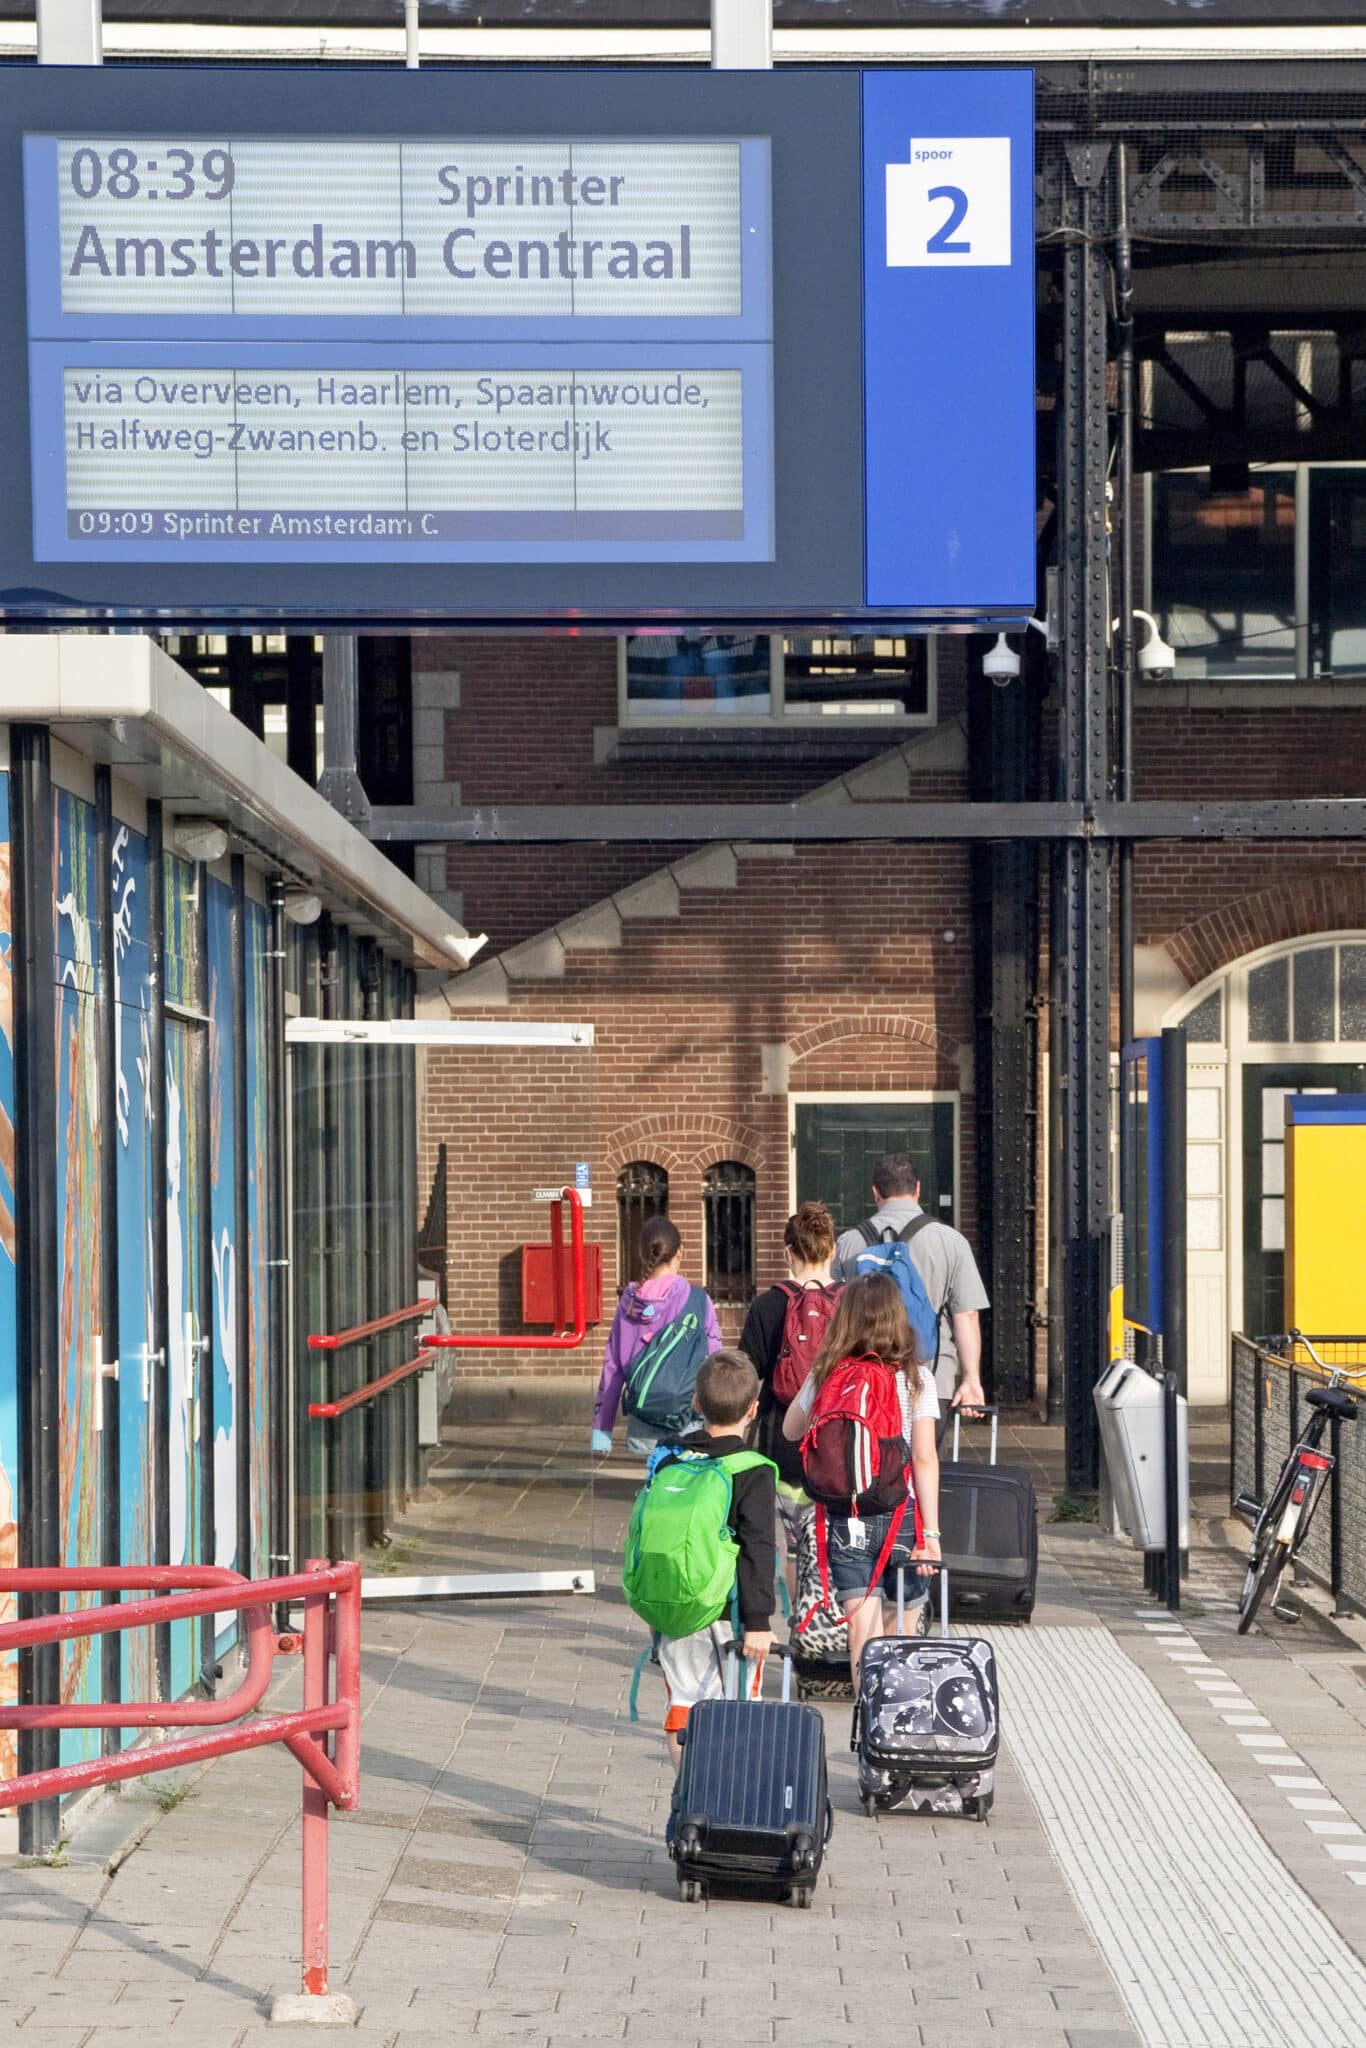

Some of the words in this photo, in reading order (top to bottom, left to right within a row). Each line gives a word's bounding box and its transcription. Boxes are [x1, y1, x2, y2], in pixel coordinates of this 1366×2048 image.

[914, 150, 953, 163] spoor
[71, 148, 235, 200] 08:39
[438, 164, 625, 218] Sprinter
[926, 185, 971, 253] 2
[68, 223, 417, 279] Amsterdam
[443, 224, 691, 279] Centraal
[73, 374, 123, 403] via
[134, 376, 302, 409] Overveen,
[317, 374, 462, 409] Haarlem,
[476, 374, 710, 415] Spaarnwoude,
[76, 418, 387, 460] Halfweg-Zwanenb.
[400, 430, 439, 451] en
[452, 420, 613, 460] Sloterdijk
[79, 512, 153, 534] 09:09
[163, 513, 262, 540] Sprinter
[269, 513, 413, 535] Amsterdam
